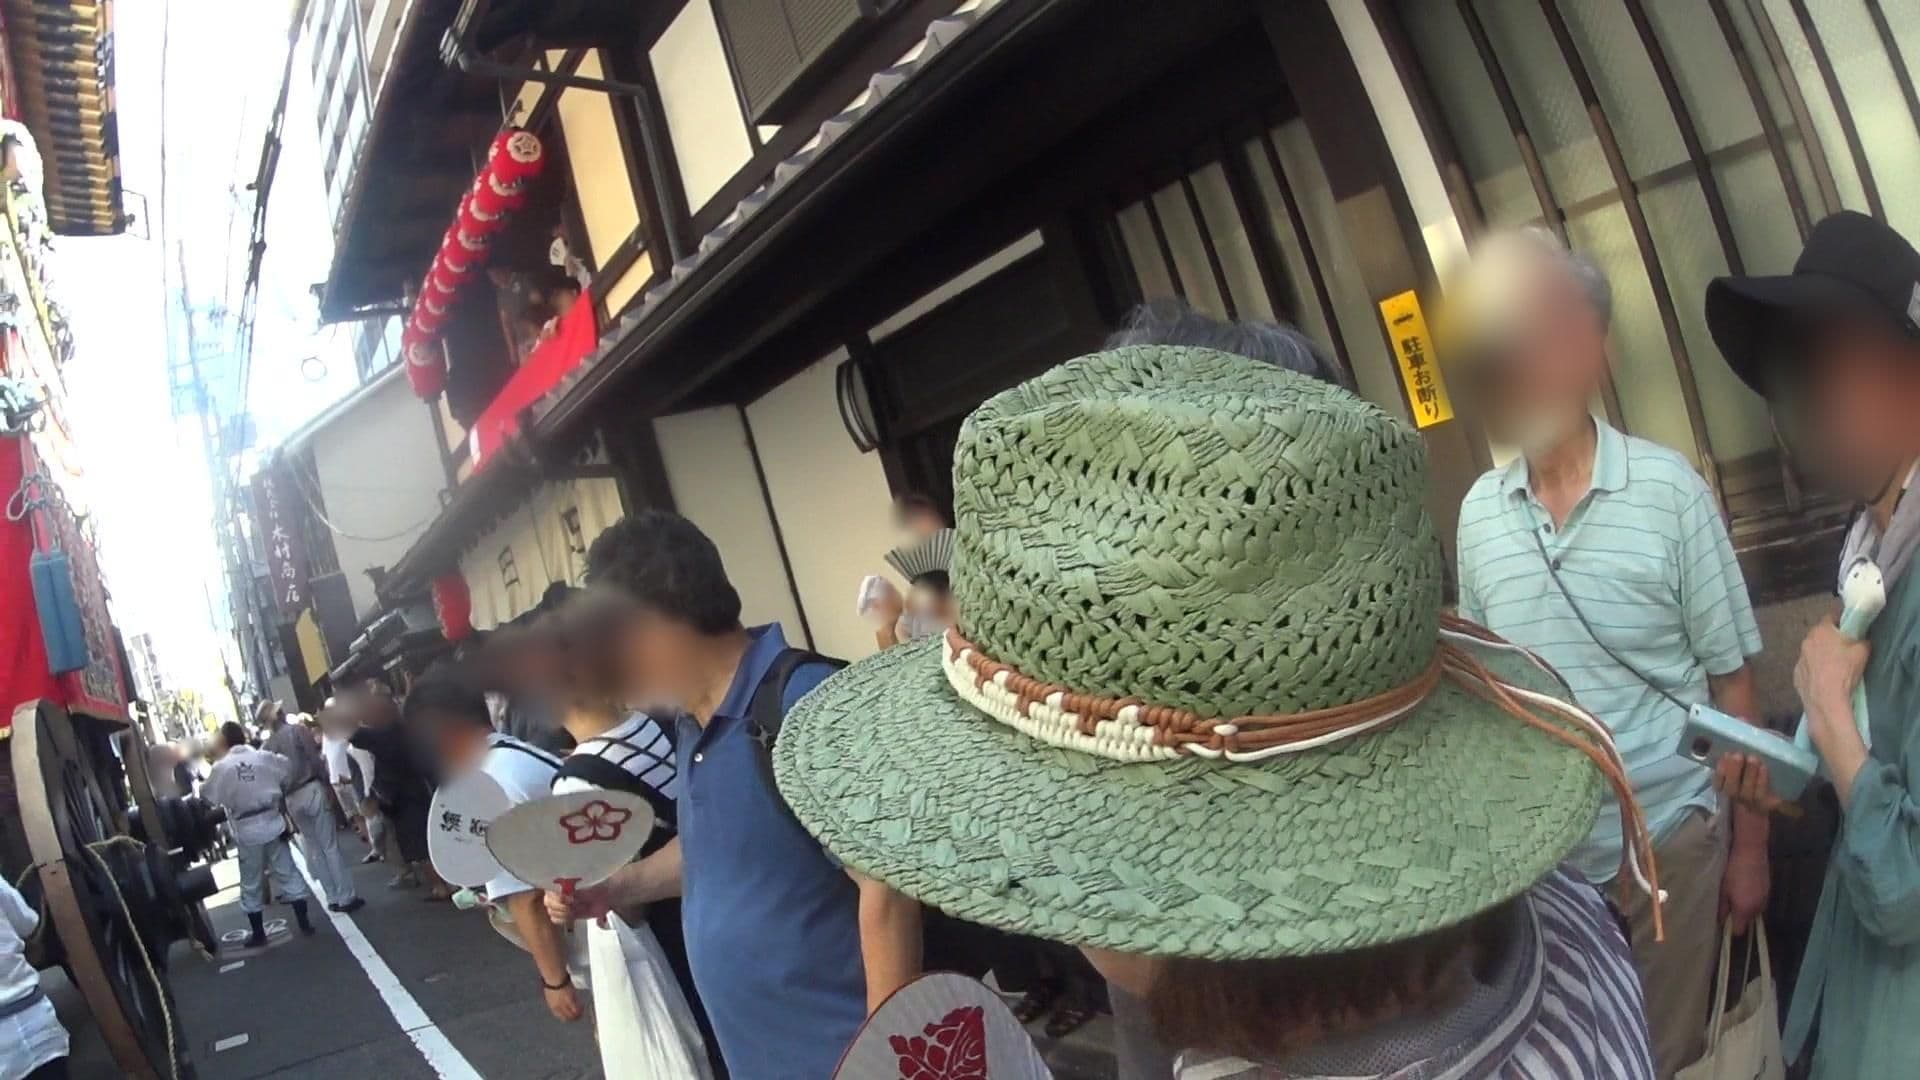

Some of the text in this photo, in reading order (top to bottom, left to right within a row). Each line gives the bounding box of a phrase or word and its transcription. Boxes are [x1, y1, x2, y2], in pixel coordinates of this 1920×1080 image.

[1401, 336, 1438, 420] 駐車お断り
